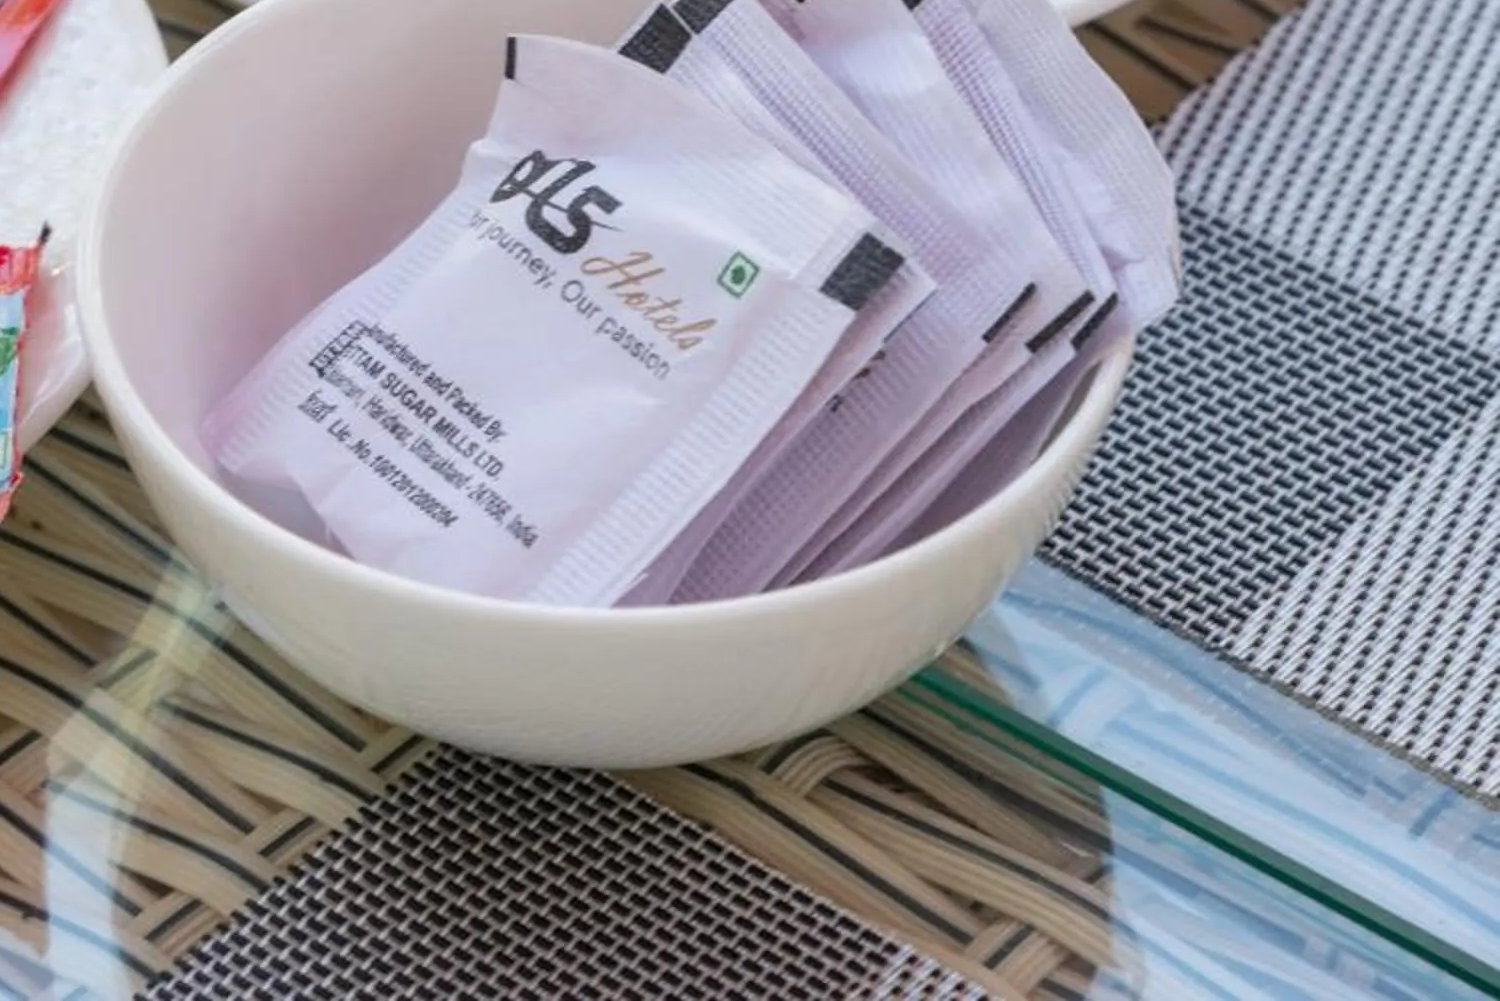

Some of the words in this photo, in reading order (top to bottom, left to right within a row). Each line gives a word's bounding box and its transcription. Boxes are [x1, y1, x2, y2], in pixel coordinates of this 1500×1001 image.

[560, 278, 603, 321] Our
[595, 315, 672, 380] passion
[580, 251, 718, 351] Hotels
[380, 371, 438, 425] SUGAR
[432, 415, 480, 460] MILLS
